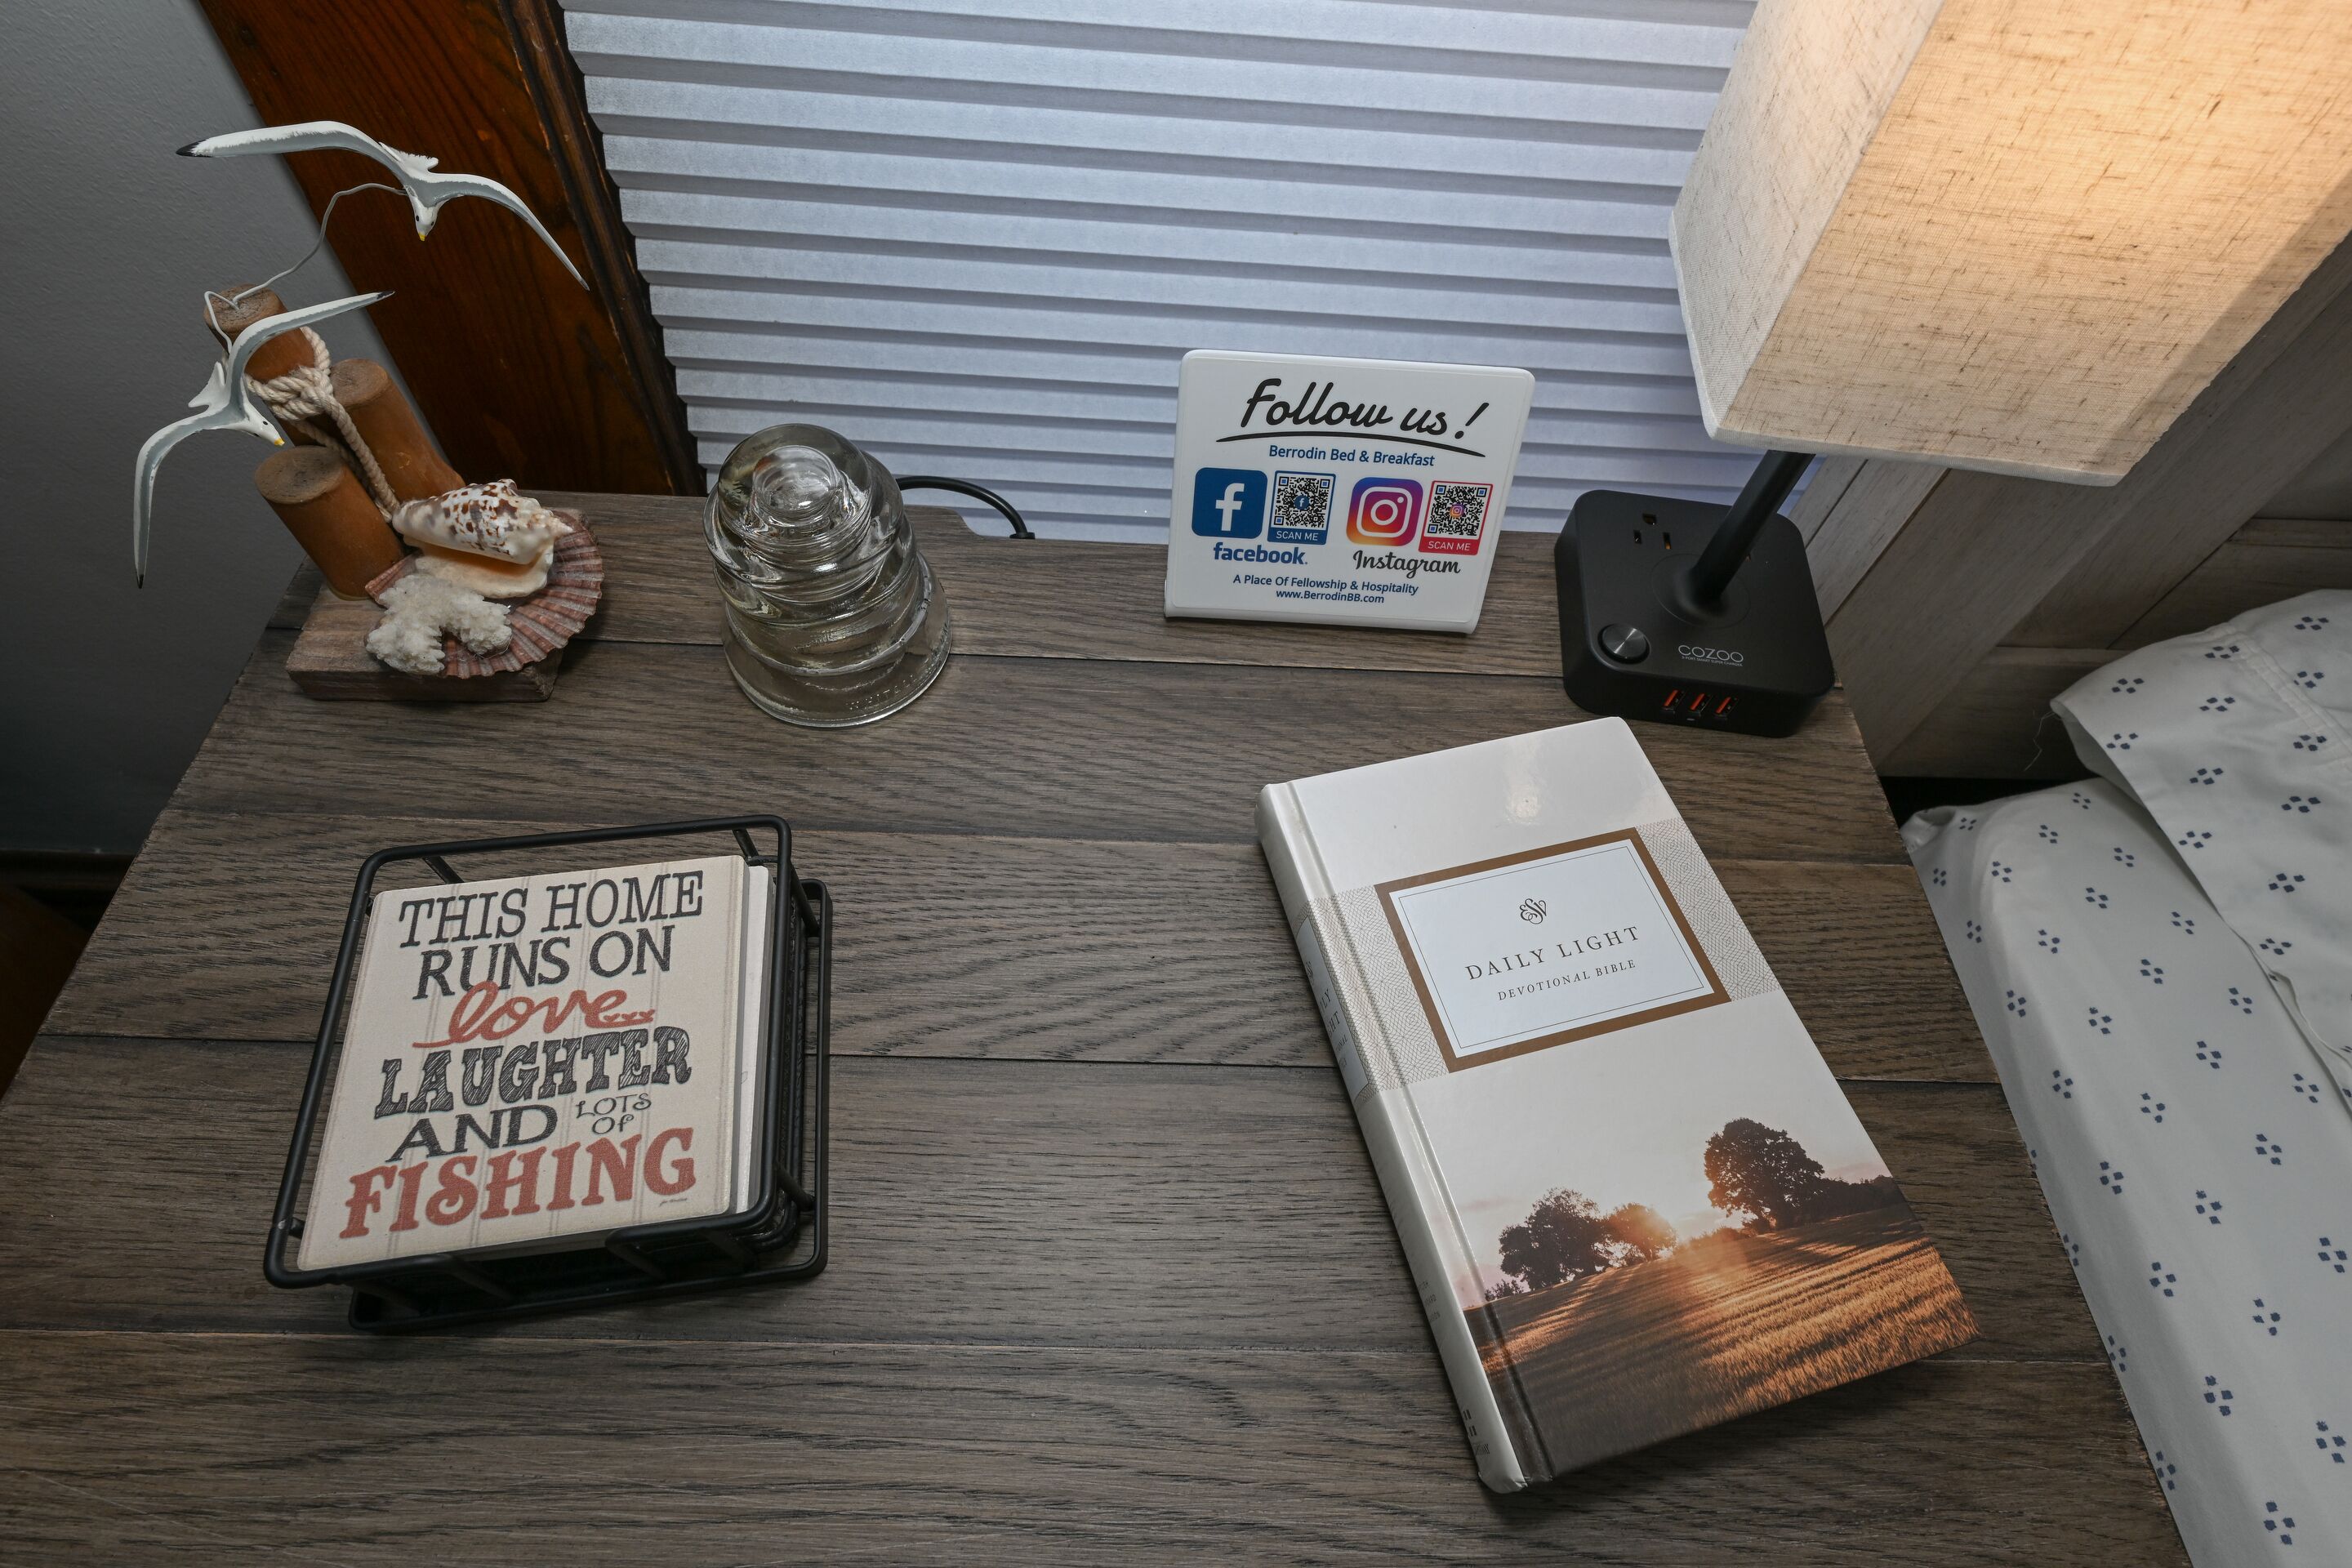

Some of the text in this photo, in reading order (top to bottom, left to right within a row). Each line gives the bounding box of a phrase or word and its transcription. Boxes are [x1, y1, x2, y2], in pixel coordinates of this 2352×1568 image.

[1241, 378, 1393, 428] Follow
[1268, 444, 1436, 467] Berrodin Bed & Breakfast
[1276, 531, 1318, 541] SCAN ME
[1428, 541, 1470, 551] SCAN ME
[1213, 542, 1305, 565] facebook
[1352, 550, 1461, 578] Instagram
[1233, 574, 1419, 595] A Place Of Fellowship & Hospitality
[1276, 589, 1385, 604] www.BerrodinBB.com
[1678, 644, 1744, 662] COZOO
[399, 869, 704, 947] THIS HOME
[412, 925, 675, 1000] RUNS ON
[1464, 926, 1639, 980] DAILY LIGHT
[1497, 960, 1636, 1000] DEVOTIONAL BIBLE
[374, 1026, 693, 1120] LAUGHTER
[385, 1093, 653, 1163] AND LOTS
[339, 1127, 697, 1240] FISHING
